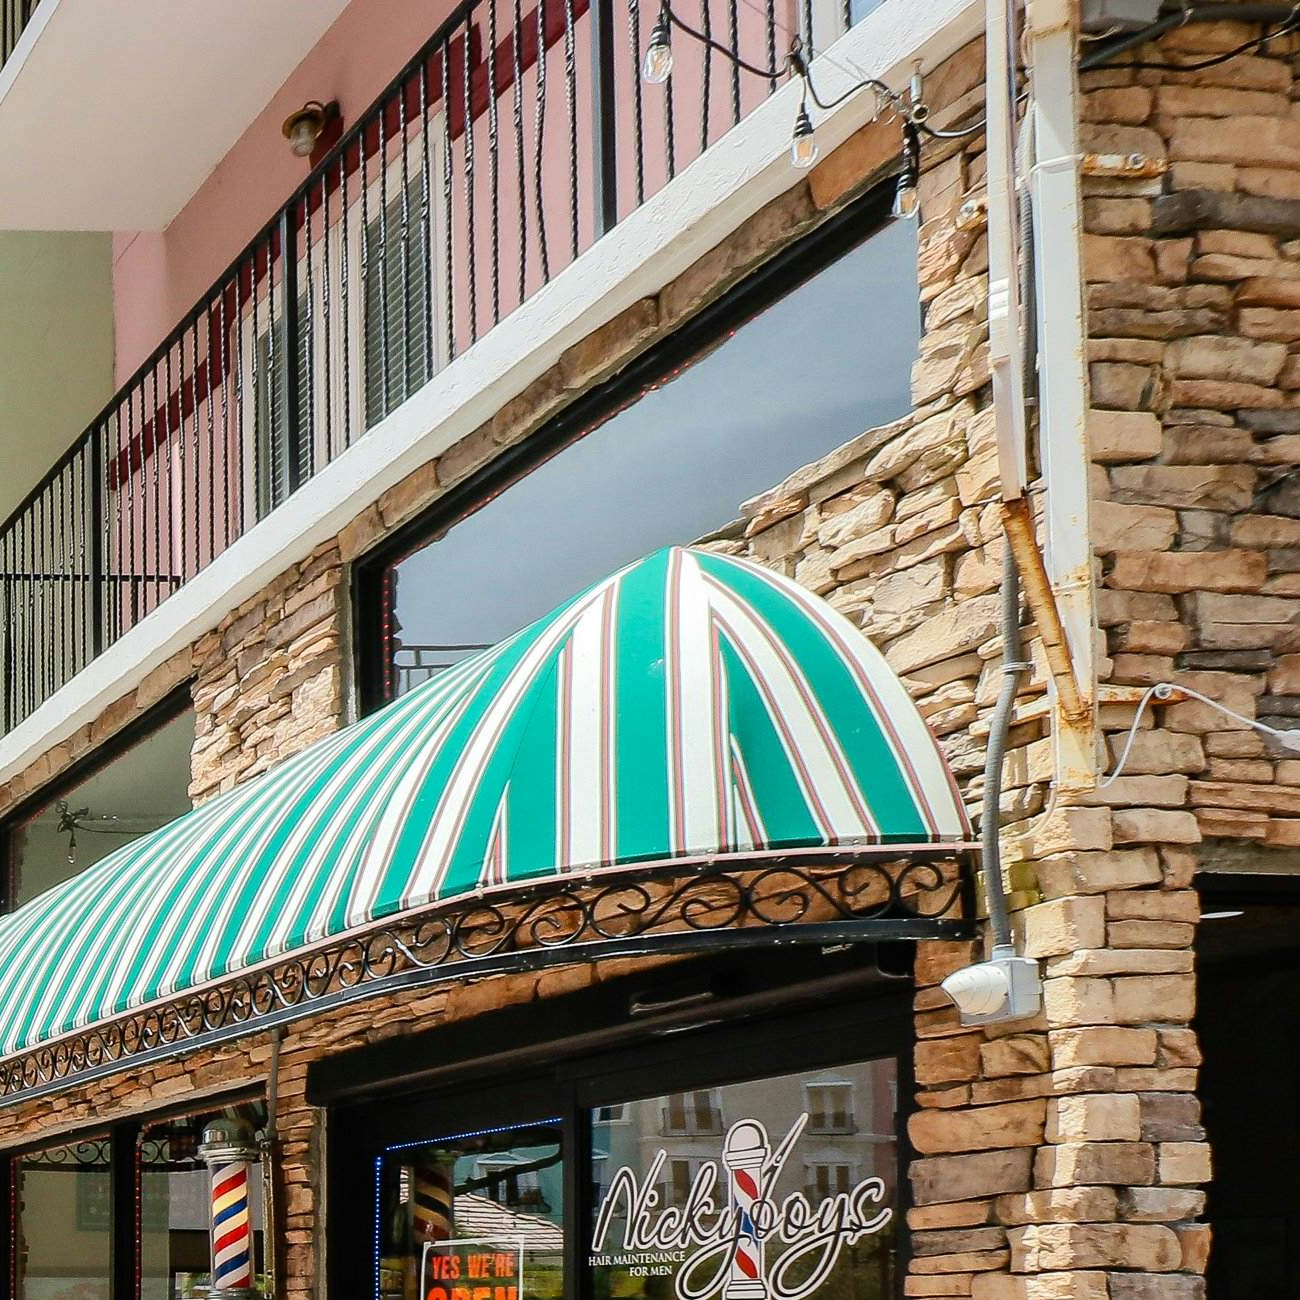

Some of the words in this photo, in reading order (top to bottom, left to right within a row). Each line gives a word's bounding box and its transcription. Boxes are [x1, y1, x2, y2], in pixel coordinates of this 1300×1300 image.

[432, 1255, 460, 1280] YES
[467, 1252, 514, 1278] WE'RE
[588, 1255, 612, 1267] HAIR
[613, 1250, 686, 1265] MAINTENANCE
[629, 1266, 649, 1277] FOR
[650, 1265, 673, 1276] MEN
